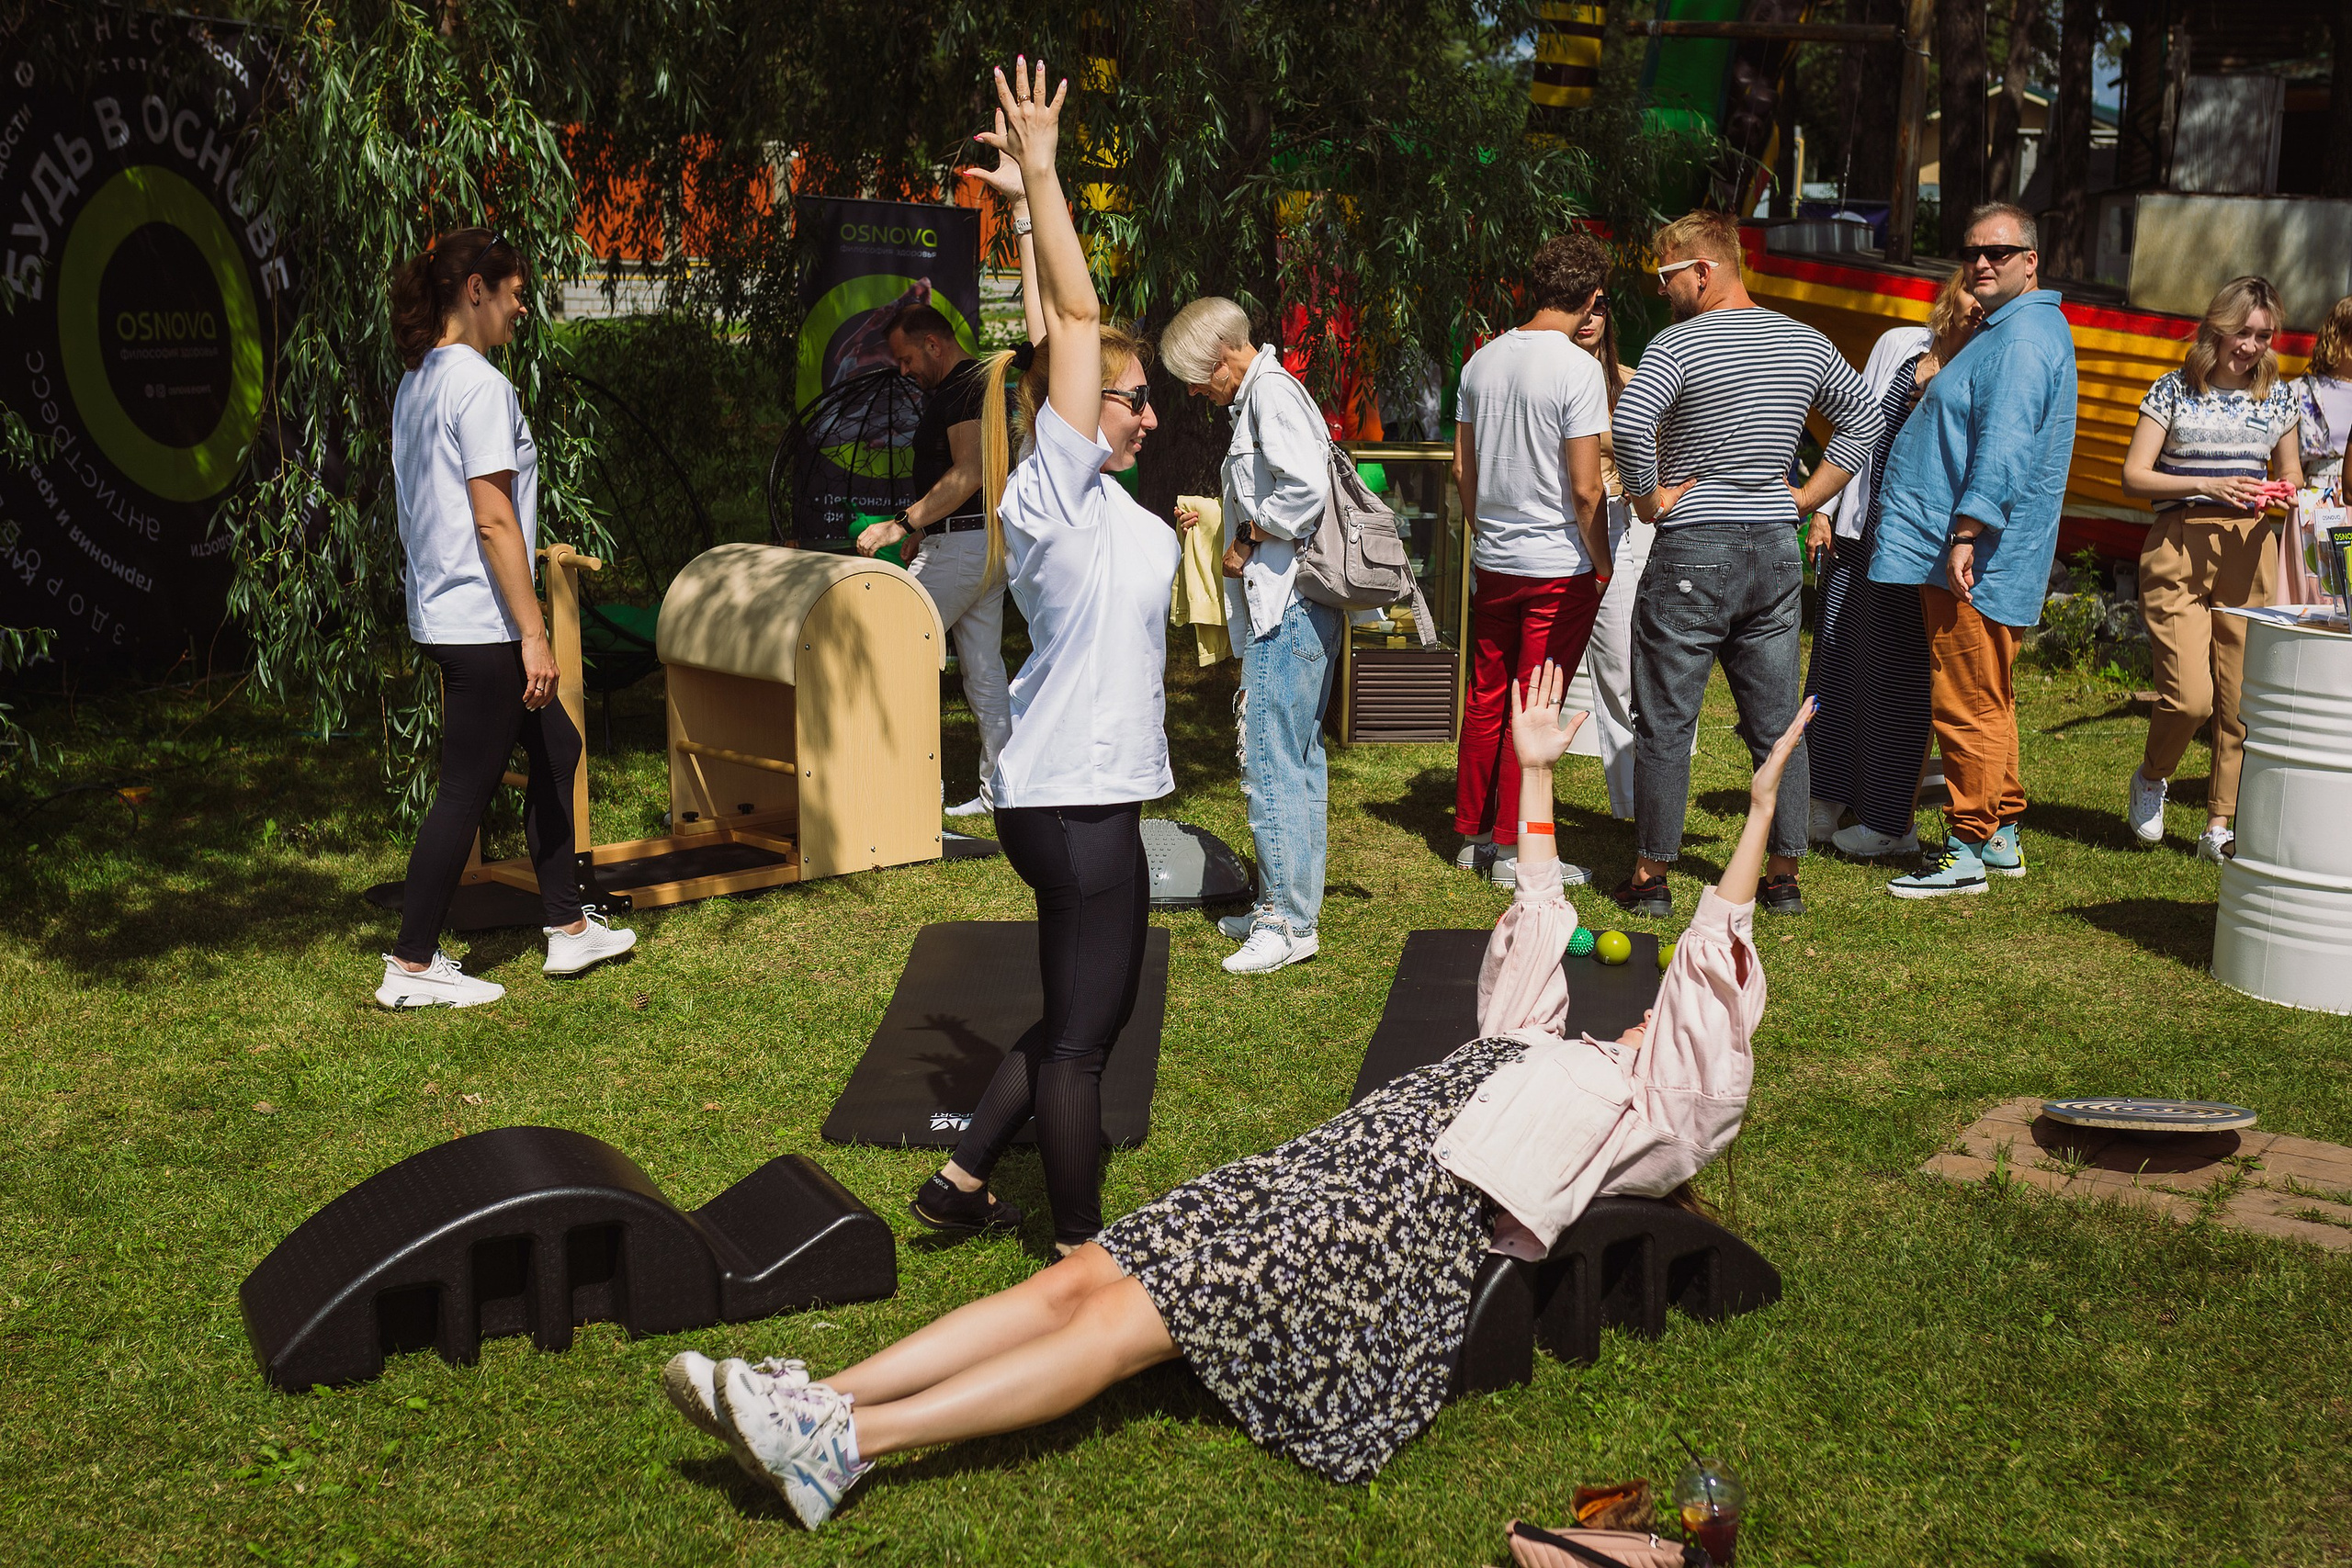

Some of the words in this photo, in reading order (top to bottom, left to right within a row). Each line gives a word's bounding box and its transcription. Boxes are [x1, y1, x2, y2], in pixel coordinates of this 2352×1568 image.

[6, 131, 95, 301] БУДЬ
[93, 95, 130, 152] В
[141, 94, 291, 300] ОСНОВЕ
